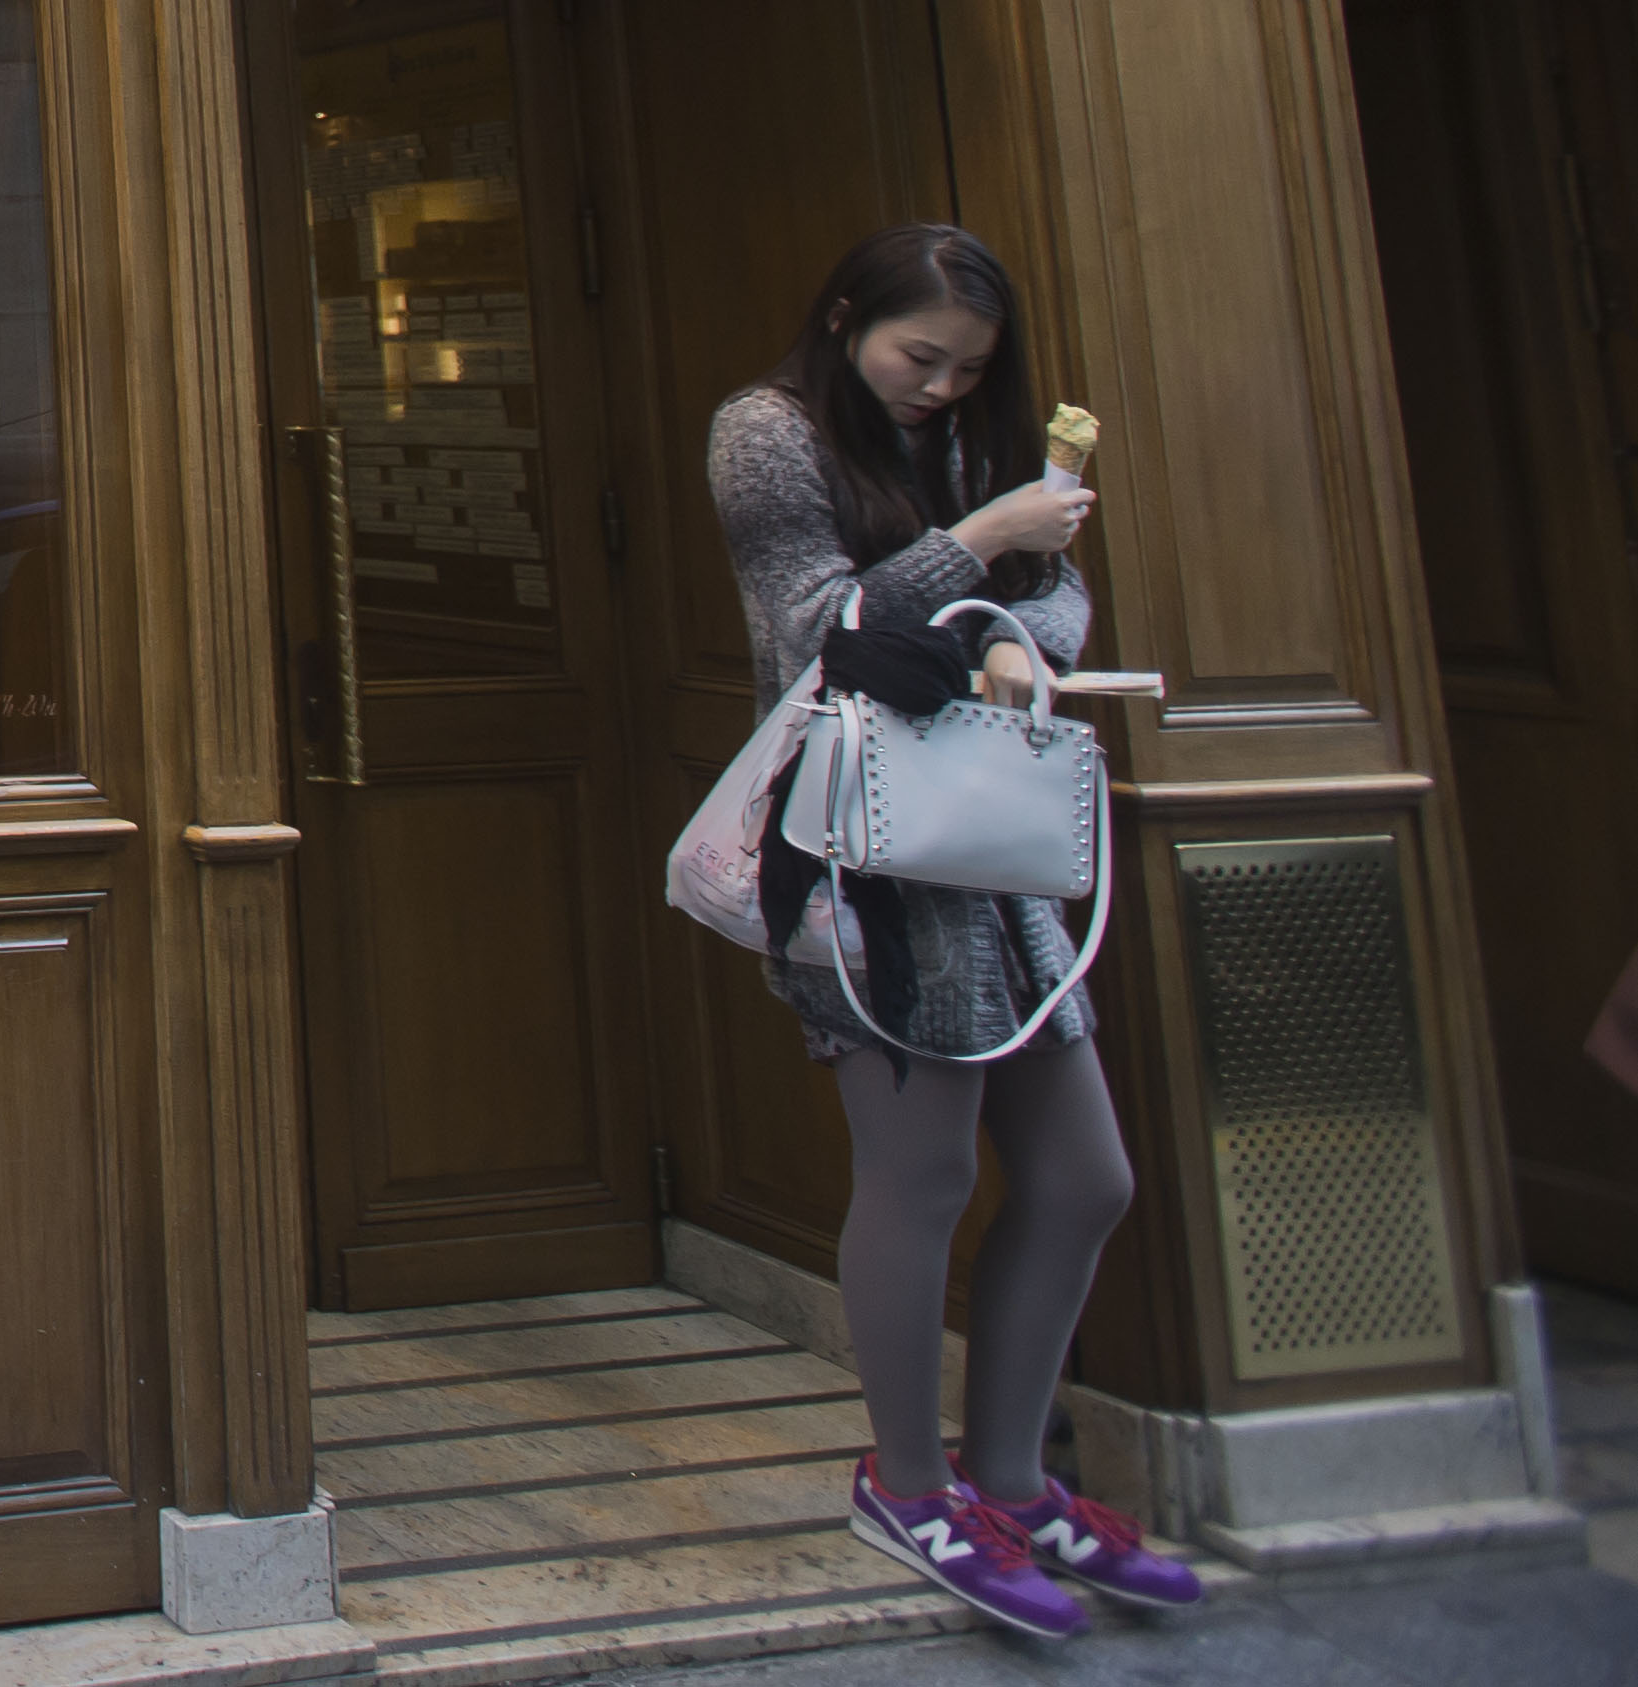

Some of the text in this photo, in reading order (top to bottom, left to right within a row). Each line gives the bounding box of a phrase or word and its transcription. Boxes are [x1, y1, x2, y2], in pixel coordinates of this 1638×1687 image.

[695, 841, 735, 875] ERIC
[909, 1518, 975, 1563] N
[1030, 1518, 1100, 1564] N
